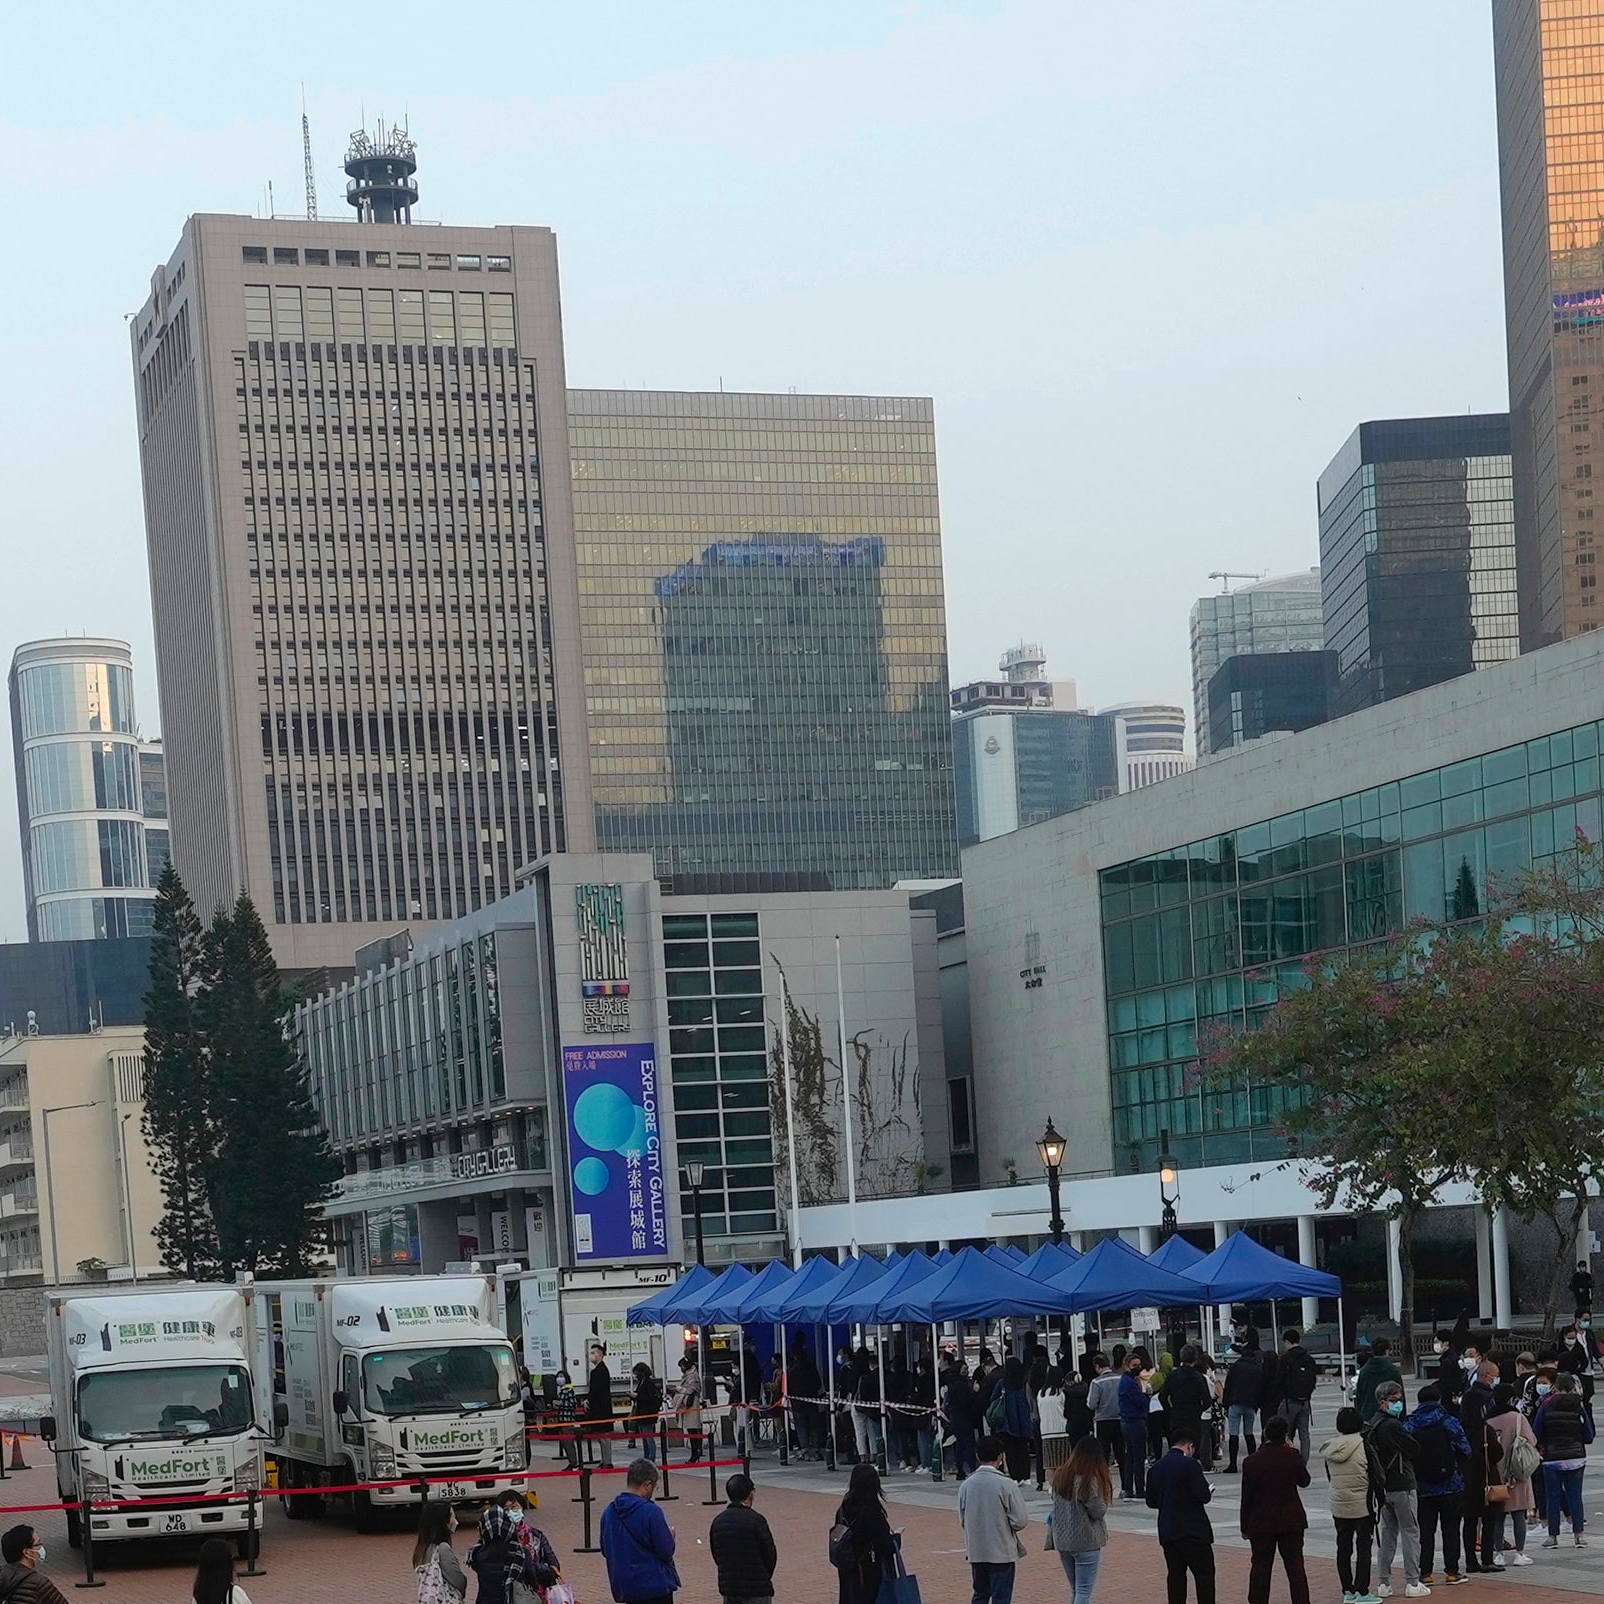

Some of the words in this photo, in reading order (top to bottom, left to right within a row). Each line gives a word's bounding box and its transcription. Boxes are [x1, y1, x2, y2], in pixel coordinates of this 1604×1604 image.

[584, 1023, 632, 1034] GALLERY
[565, 1051, 584, 1061] FREE
[586, 1049, 628, 1060] ADMISSION
[640, 1059, 658, 1134] EXPLORE
[646, 1135, 662, 1174] CITY
[625, 1148, 647, 1250] 探索展城館
[648, 1175, 666, 1249] GALLERY
[638, 1274, 668, 1284] MF-10
[336, 1315, 361, 1327] MF-02
[398, 1318, 432, 1327] MedFort
[119, 1336, 158, 1346] MedFort
[414, 1429, 485, 1447] MedFort
[130, 1457, 210, 1477] MedFort
[131, 1473, 177, 1482] Healthcare
[180, 1471, 211, 1479] Limited
[441, 1487, 467, 1498] 5838
[167, 1514, 183, 1523] WD
[165, 1522, 187, 1532] 648
